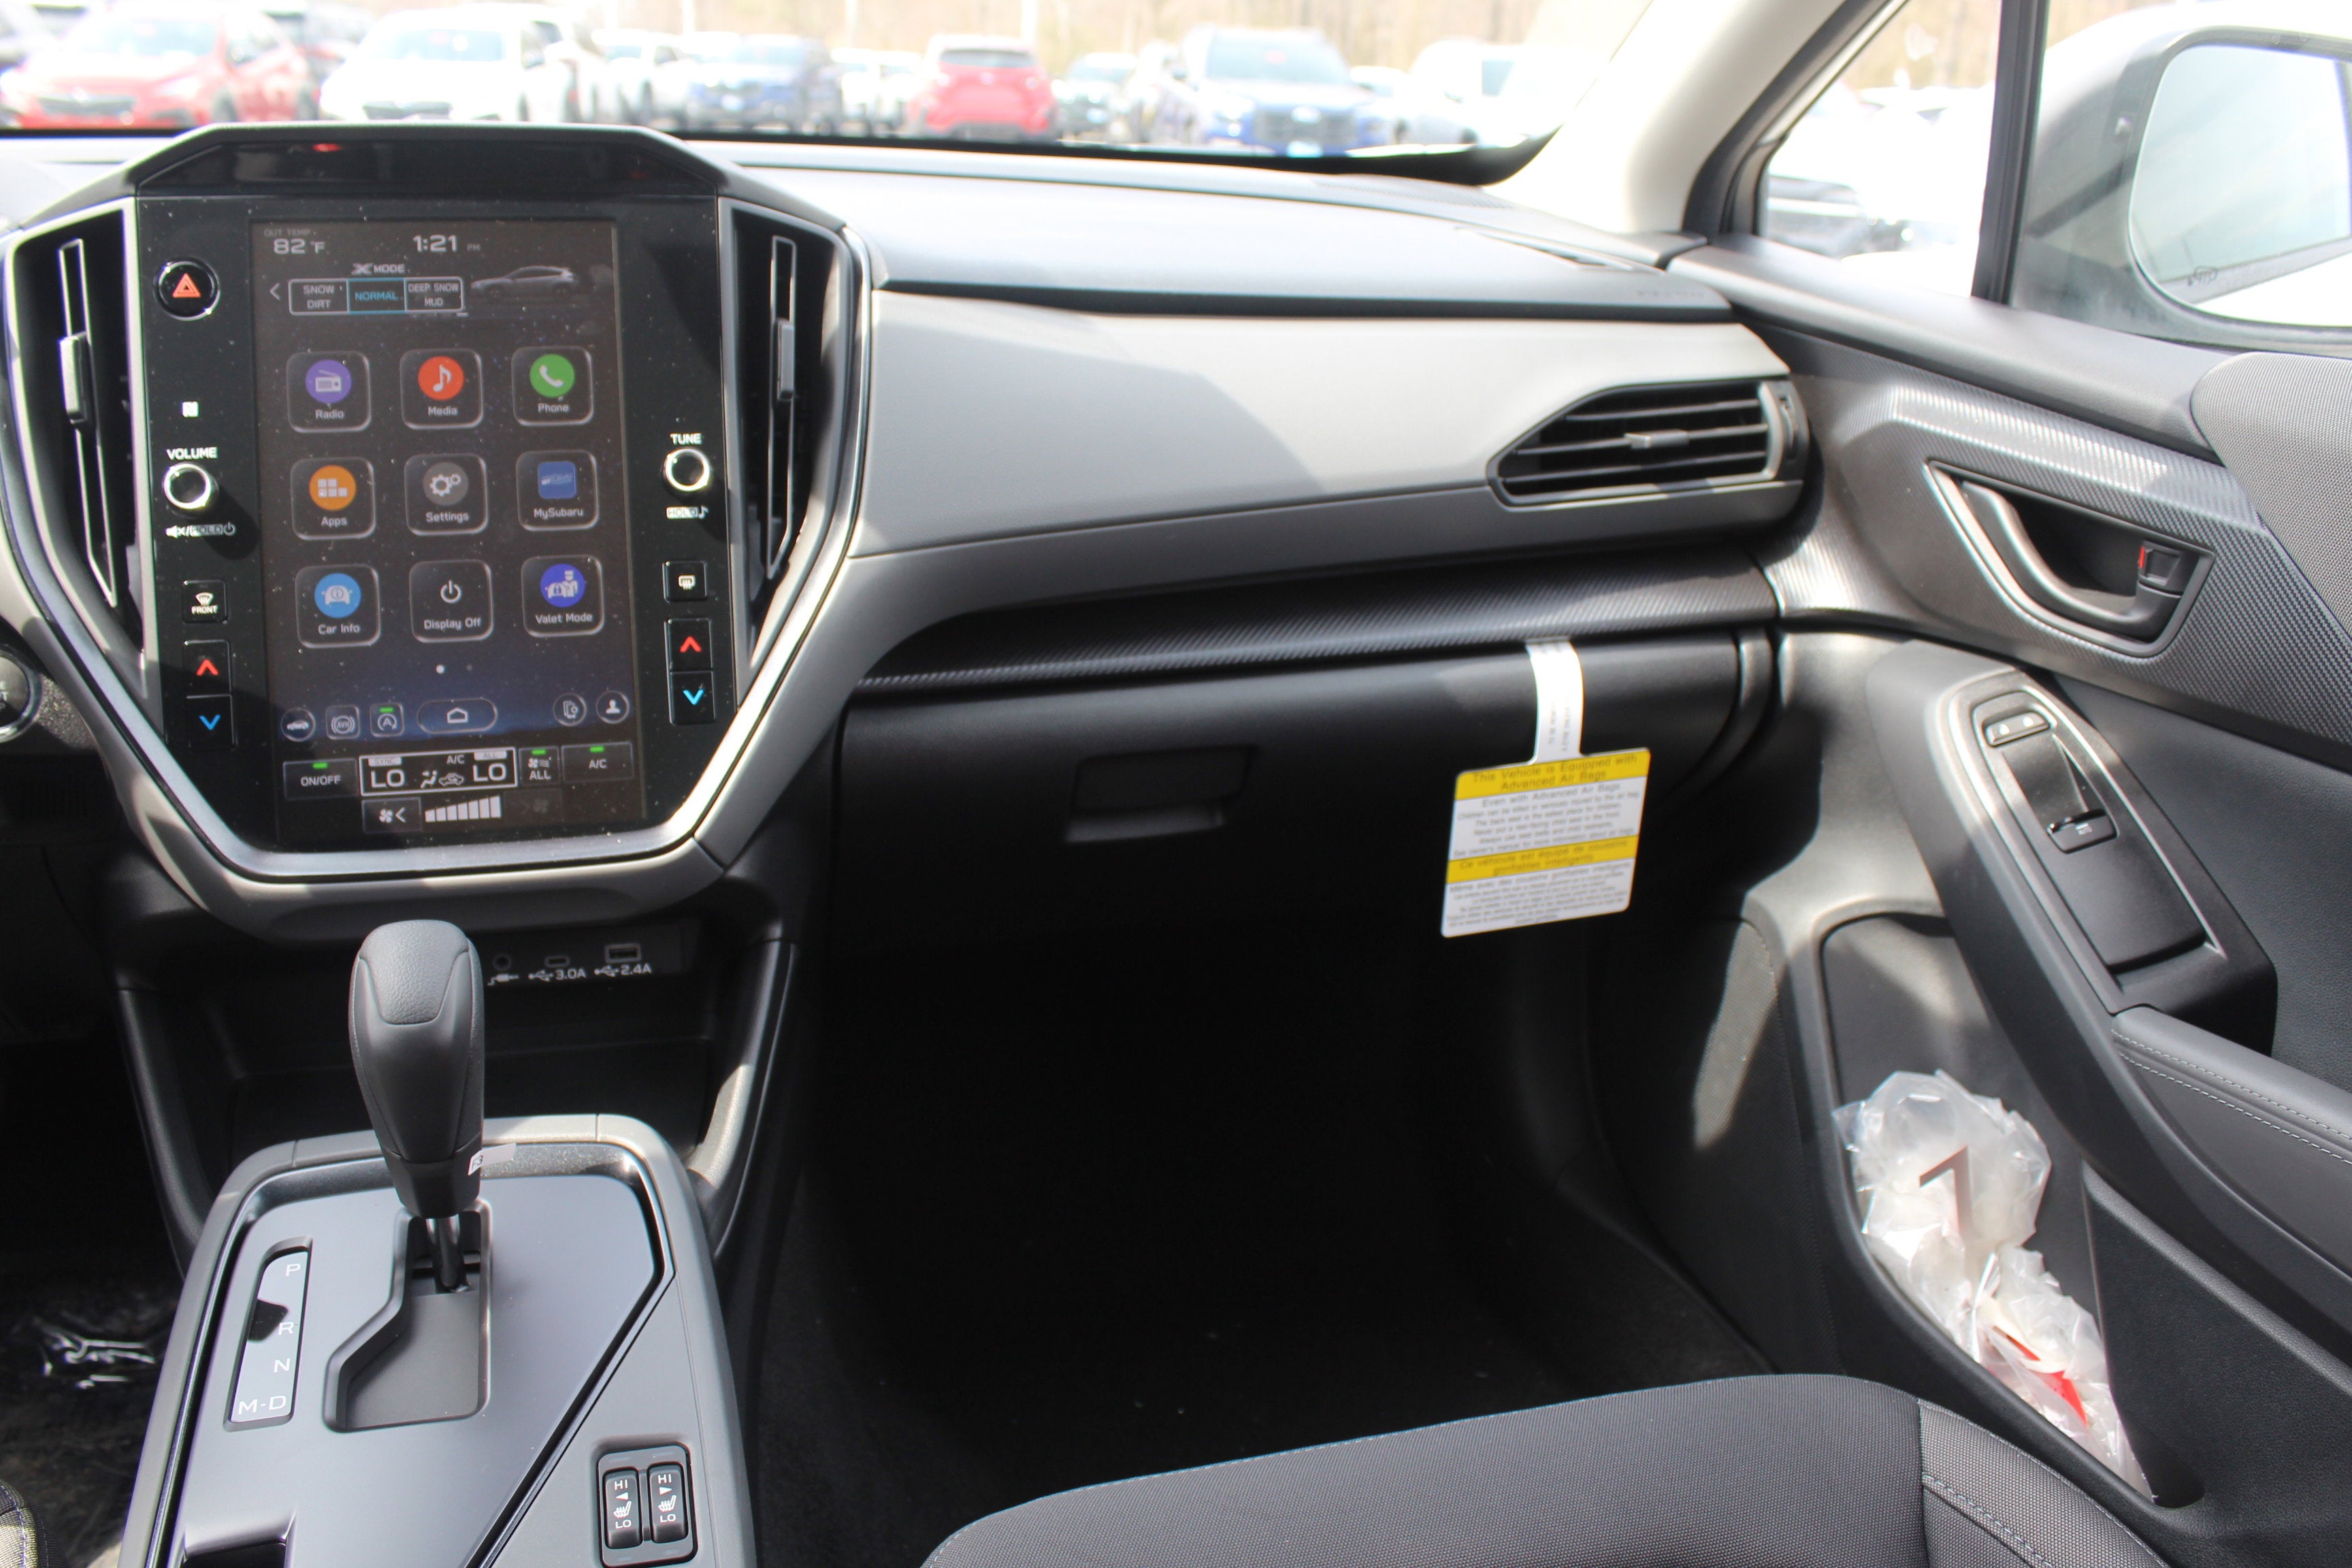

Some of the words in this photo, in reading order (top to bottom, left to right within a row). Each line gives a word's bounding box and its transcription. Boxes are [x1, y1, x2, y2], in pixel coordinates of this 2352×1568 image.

[274, 238, 306, 255] 82
[413, 235, 457, 252] 1:21
[374, 264, 405, 273] MODE
[303, 284, 334, 295] SNOW
[408, 283, 430, 293] DEEP
[434, 283, 458, 293] SNOW
[355, 291, 398, 301] NORMAL
[307, 299, 331, 309] DIRT
[425, 297, 443, 307] MUD
[428, 406, 458, 416] Media
[538, 403, 569, 413] Phone
[315, 409, 344, 420] Radio
[670, 433, 702, 444] TUNE
[166, 446, 218, 460] VOLUME
[425, 511, 469, 523] Settings
[534, 508, 584, 520] MySubaru
[668, 507, 698, 519] HOLD
[321, 516, 347, 527] Apps
[191, 605, 218, 615] FRONT
[536, 613, 562, 624] Valet
[566, 612, 593, 623] Mode
[318, 623, 336, 634] Car
[340, 623, 360, 633] Info
[424, 619, 461, 631] Display
[465, 617, 482, 628] Off
[446, 755, 465, 764] A/C
[589, 760, 607, 768] A/C
[472, 763, 506, 782] LO
[1473, 773, 1496, 784] This
[1501, 767, 1541, 780] Vehicle
[1547, 765, 1555, 774] is
[1561, 757, 1611, 772] Equipped
[1616, 754, 1637, 764] with
[301, 774, 341, 786] ON/OFF
[371, 769, 405, 788] LO
[529, 770, 551, 780] ALL
[1501, 775, 1555, 791] Advanced
[1561, 772, 1575, 783] Air
[555, 968, 586, 979] 3.0A
[621, 964, 652, 975] 2.4A
[286, 1264, 301, 1276] P
[278, 1322, 294, 1335] R
[274, 1358, 290, 1372] N
[658, 1473, 672, 1484] HI
[614, 1479, 628, 1490] HI
[615, 1519, 632, 1529] LO
[660, 1514, 676, 1523] LO
